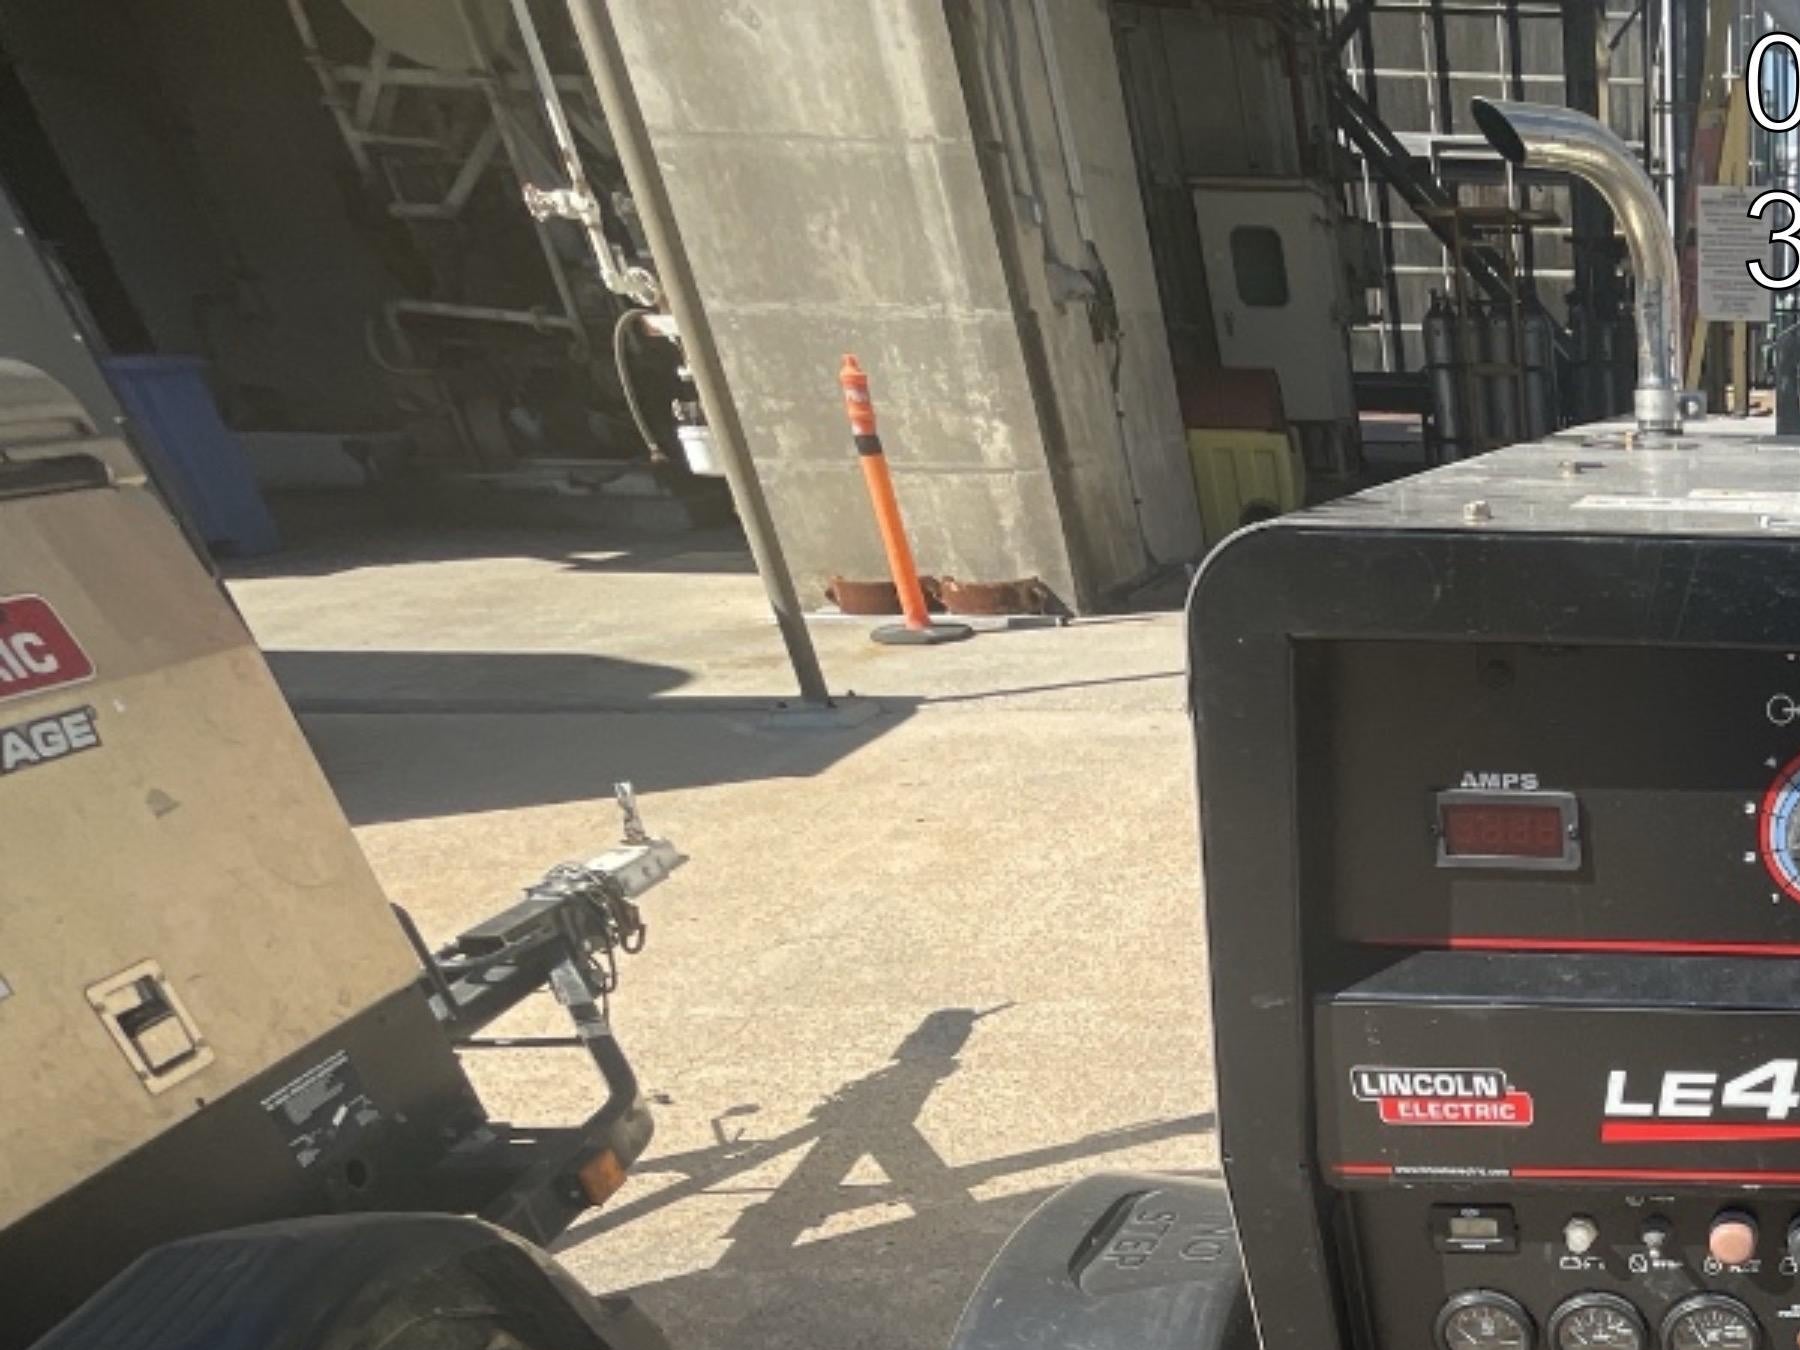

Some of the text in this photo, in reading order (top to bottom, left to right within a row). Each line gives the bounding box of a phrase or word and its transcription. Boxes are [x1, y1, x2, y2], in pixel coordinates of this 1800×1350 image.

[1460, 771, 1540, 790] AMPS
[1360, 1073, 1498, 1098] LINCOLN
[1399, 1101, 1516, 1120] ELECTRIC
